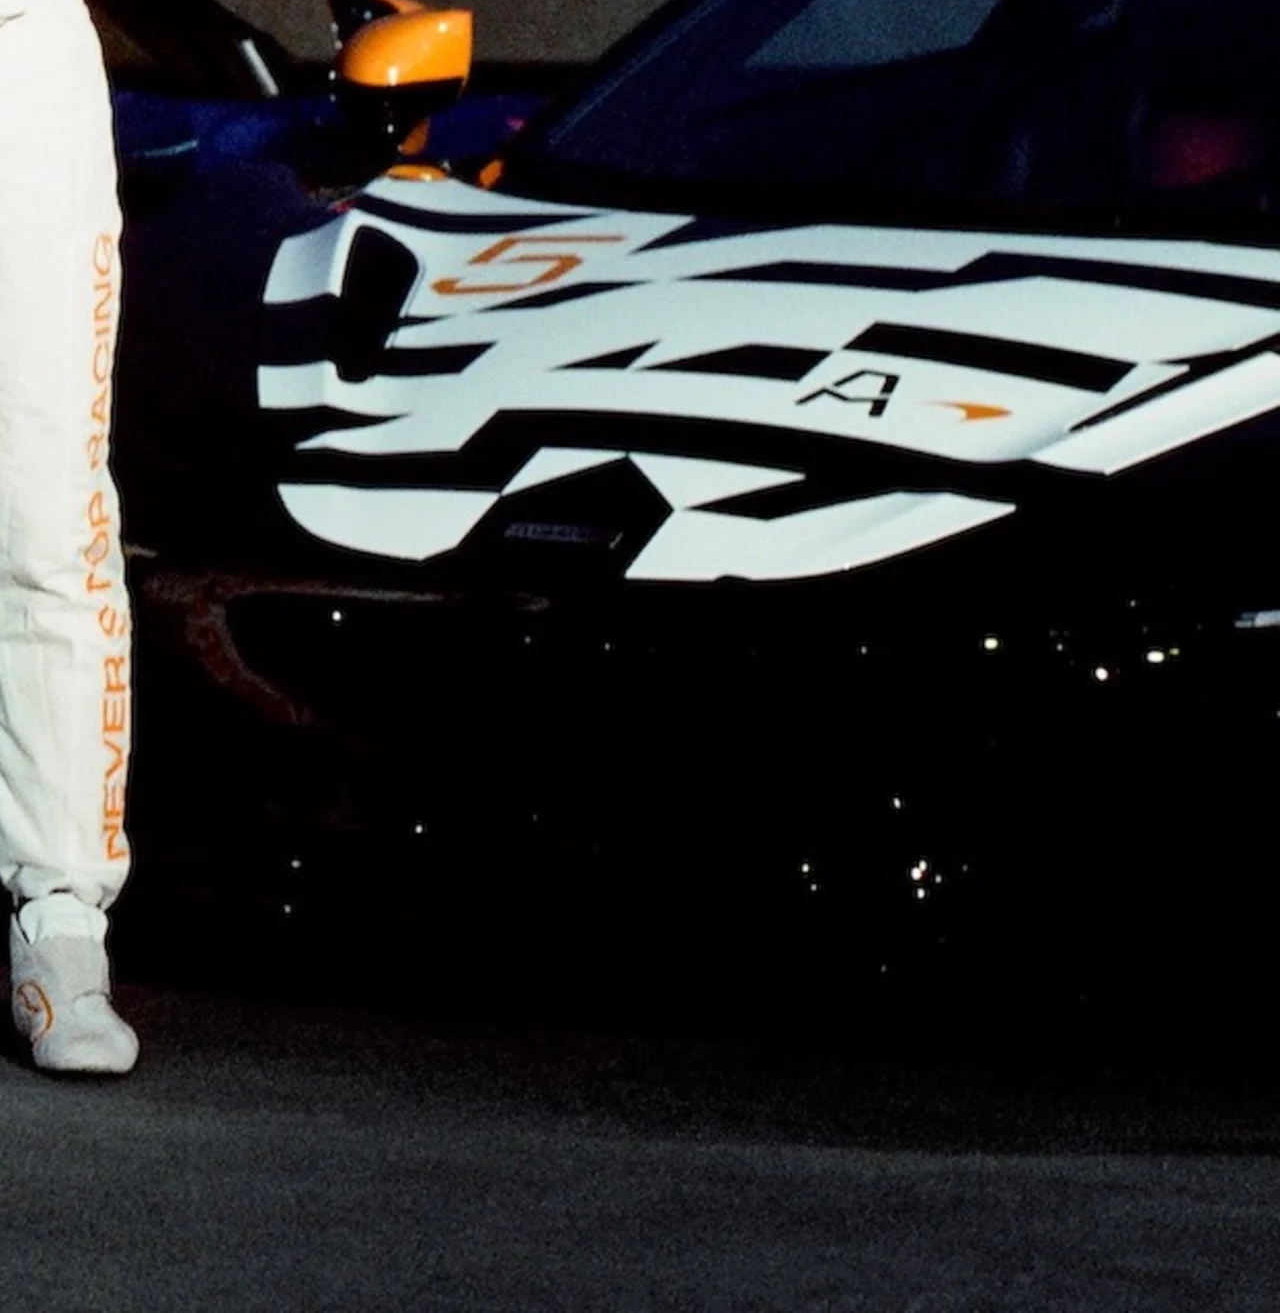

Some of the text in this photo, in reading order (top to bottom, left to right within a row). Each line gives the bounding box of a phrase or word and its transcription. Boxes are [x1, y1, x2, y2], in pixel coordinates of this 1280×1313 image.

[431, 234, 627, 296] 5
[82, 233, 129, 862] NEVER STOP RACING
